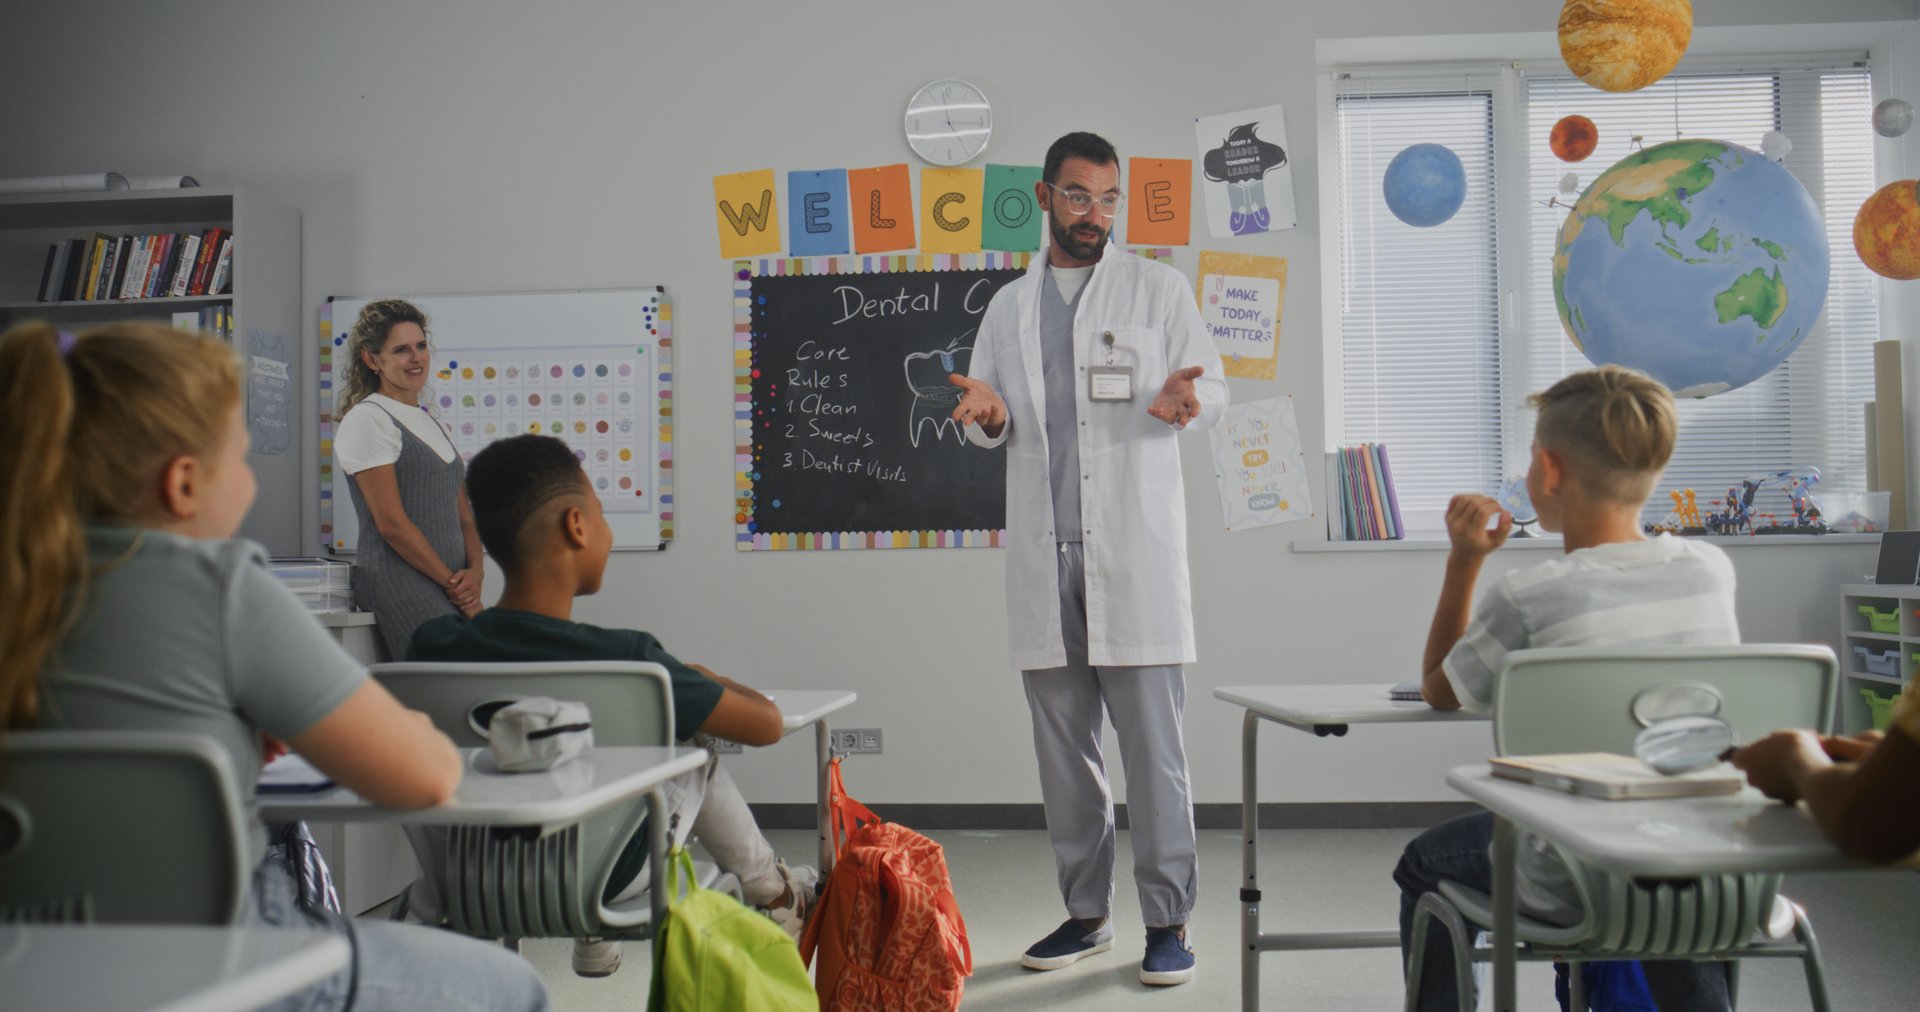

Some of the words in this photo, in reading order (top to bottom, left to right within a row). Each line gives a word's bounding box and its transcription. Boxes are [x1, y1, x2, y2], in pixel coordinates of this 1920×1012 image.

[1224, 145, 1259, 159] READER
[1229, 139, 1247, 148] TODAY
[1225, 157, 1255, 167] TOMORROW
[1227, 164, 1261, 177] LEADER
[719, 180, 1175, 236] WELCOE
[832, 281, 940, 326] Dental
[963, 278, 991, 315] C
[1226, 288, 1259, 302] MAKE
[1220, 306, 1261, 322] TODAY
[1213, 325, 1263, 342] MATTER
[796, 340, 851, 361] Care
[786, 368, 848, 389] Rules
[800, 393, 857, 416] Clean
[808, 418, 874, 448] Sweets
[802, 448, 863, 473] Dentist
[867, 460, 906, 482] Visits
